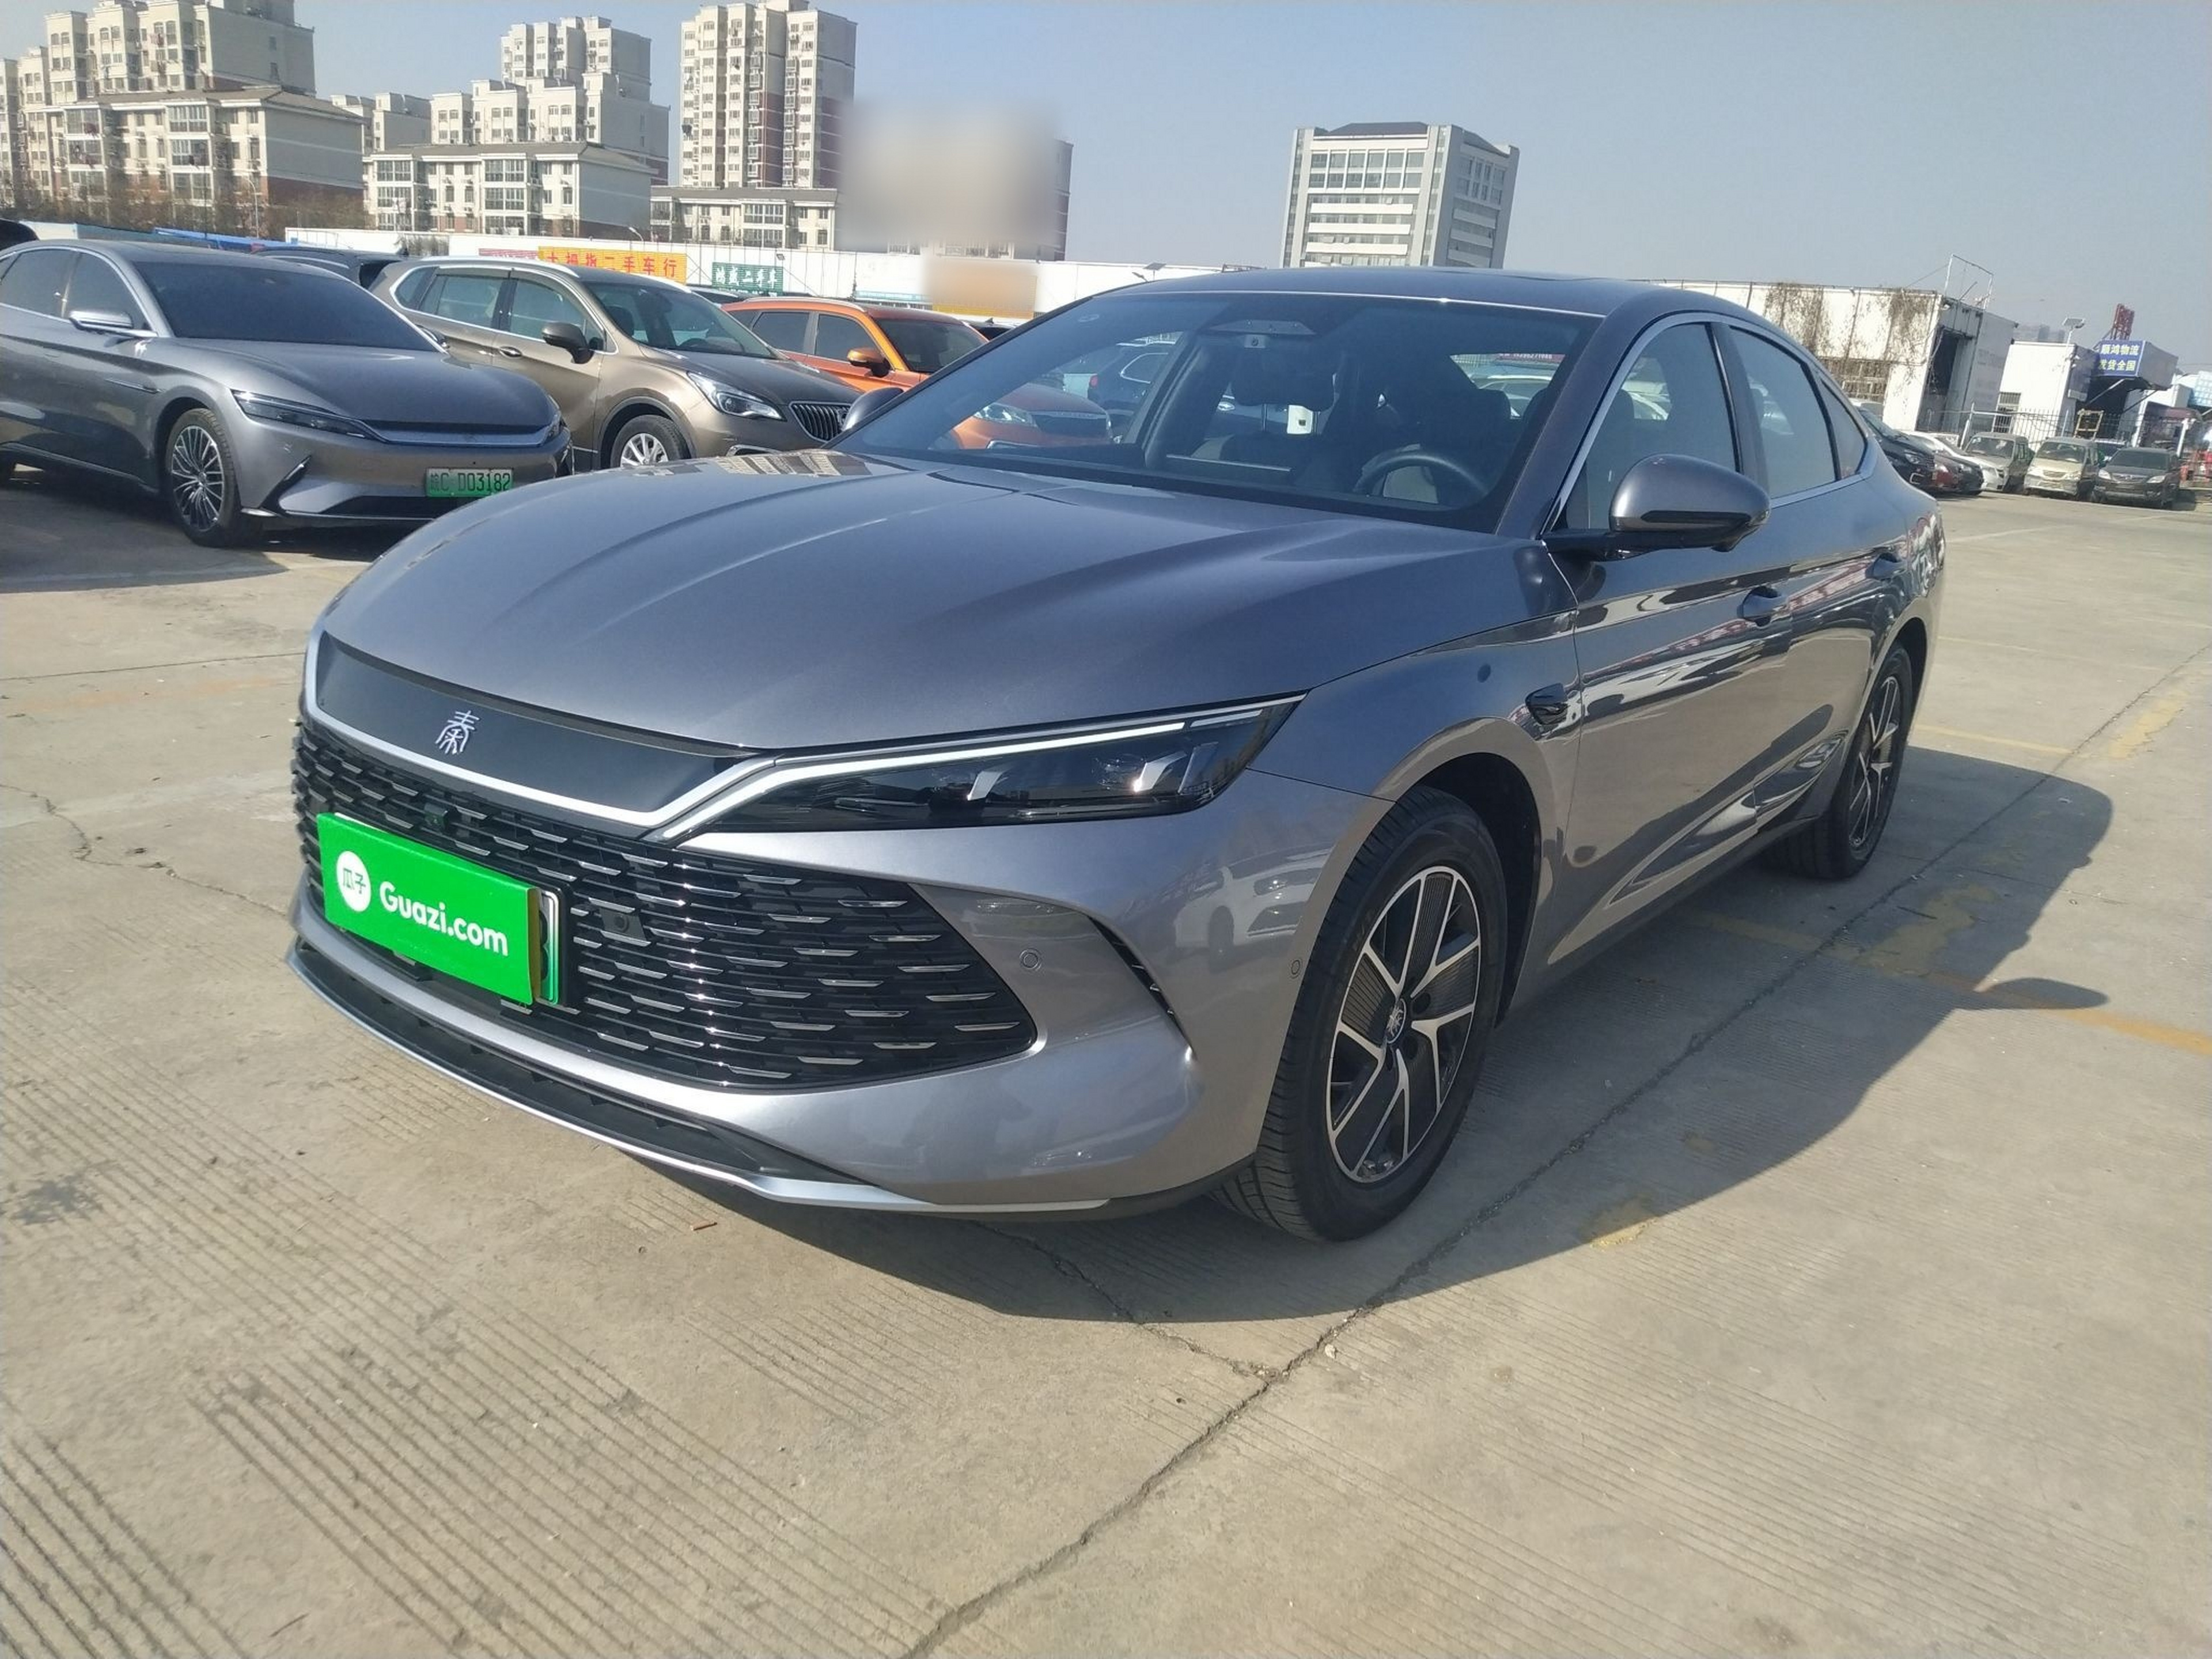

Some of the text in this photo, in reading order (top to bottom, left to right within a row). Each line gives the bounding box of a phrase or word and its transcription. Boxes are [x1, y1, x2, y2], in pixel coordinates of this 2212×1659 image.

[2099, 359, 2137, 371] 发货全国
[343, 868, 366, 895] 瓜子
[380, 881, 508, 956] Guazi.com
